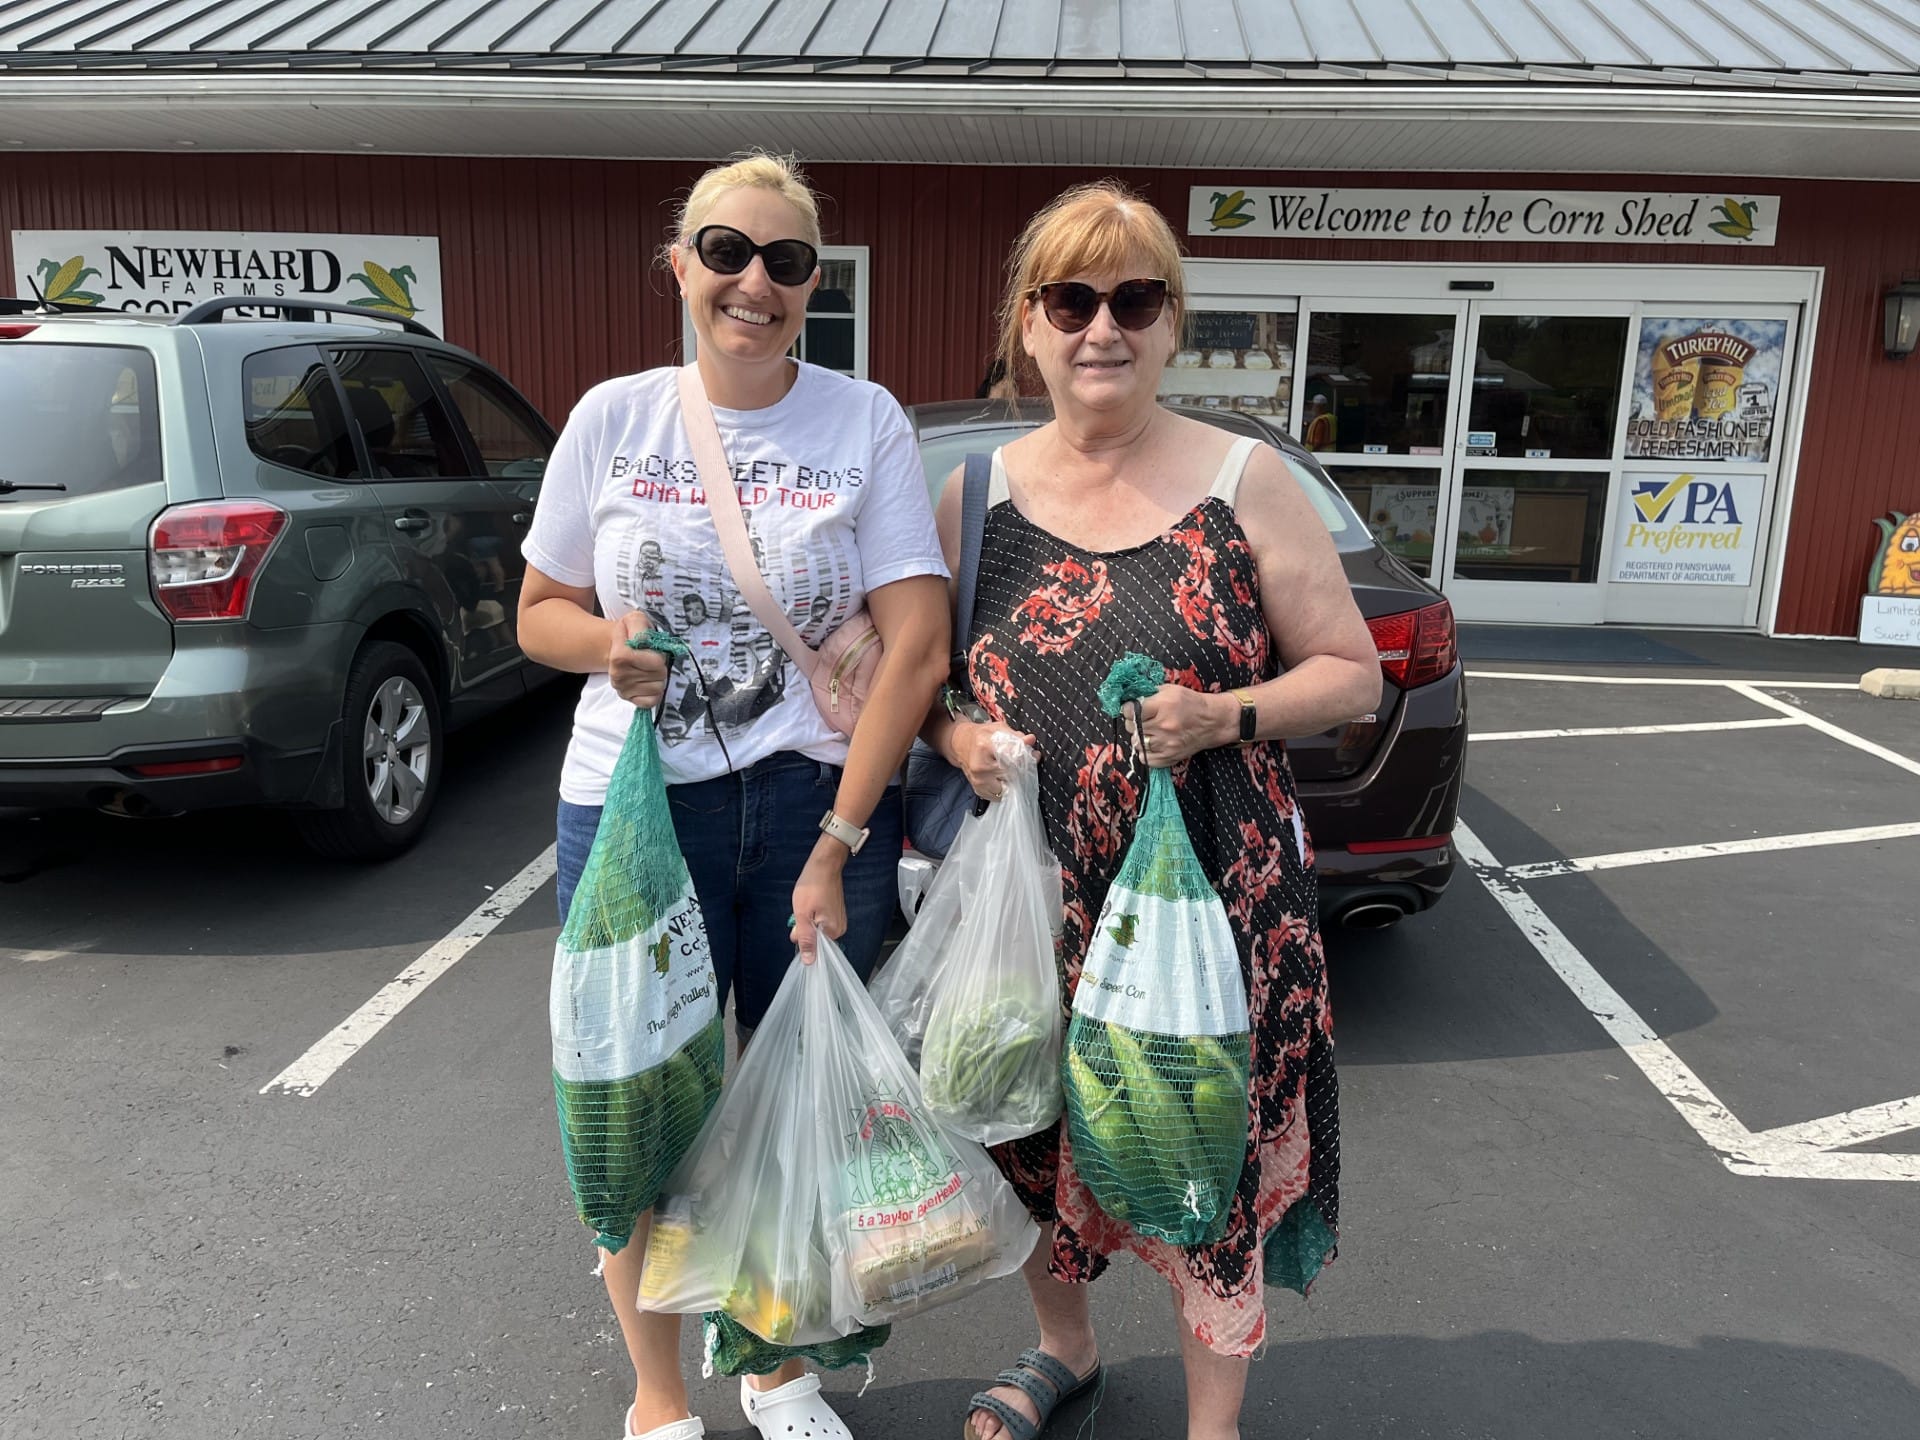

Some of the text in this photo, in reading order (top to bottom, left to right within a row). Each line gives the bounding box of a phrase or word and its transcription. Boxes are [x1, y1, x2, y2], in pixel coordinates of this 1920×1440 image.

[1269, 193, 1700, 237] Welcome to the Corn Shed
[104, 246, 342, 294] NEWHARD
[162, 280, 285, 297] FARMS
[1667, 337, 1749, 363] TURKEY HILL
[1640, 440, 1752, 457] REFRESHMENT
[612, 454, 863, 490] BACKSEET BOYS
[632, 479, 836, 510] DNA WLD TOUR
[1680, 481, 1743, 525] PA
[1624, 523, 1743, 554] Preferred
[21, 564, 124, 575] FORESTER
[1619, 570, 1736, 582] DEPARTMENT OF AGRICULTURE
[1625, 561, 1731, 571] REGISTERED PENNSYLVANIA
[1873, 626, 1910, 641] Sweet
[647, 983, 710, 1036] The Valley
[858, 1215, 864, 1228] 5
[866, 1216, 875, 1227] a
